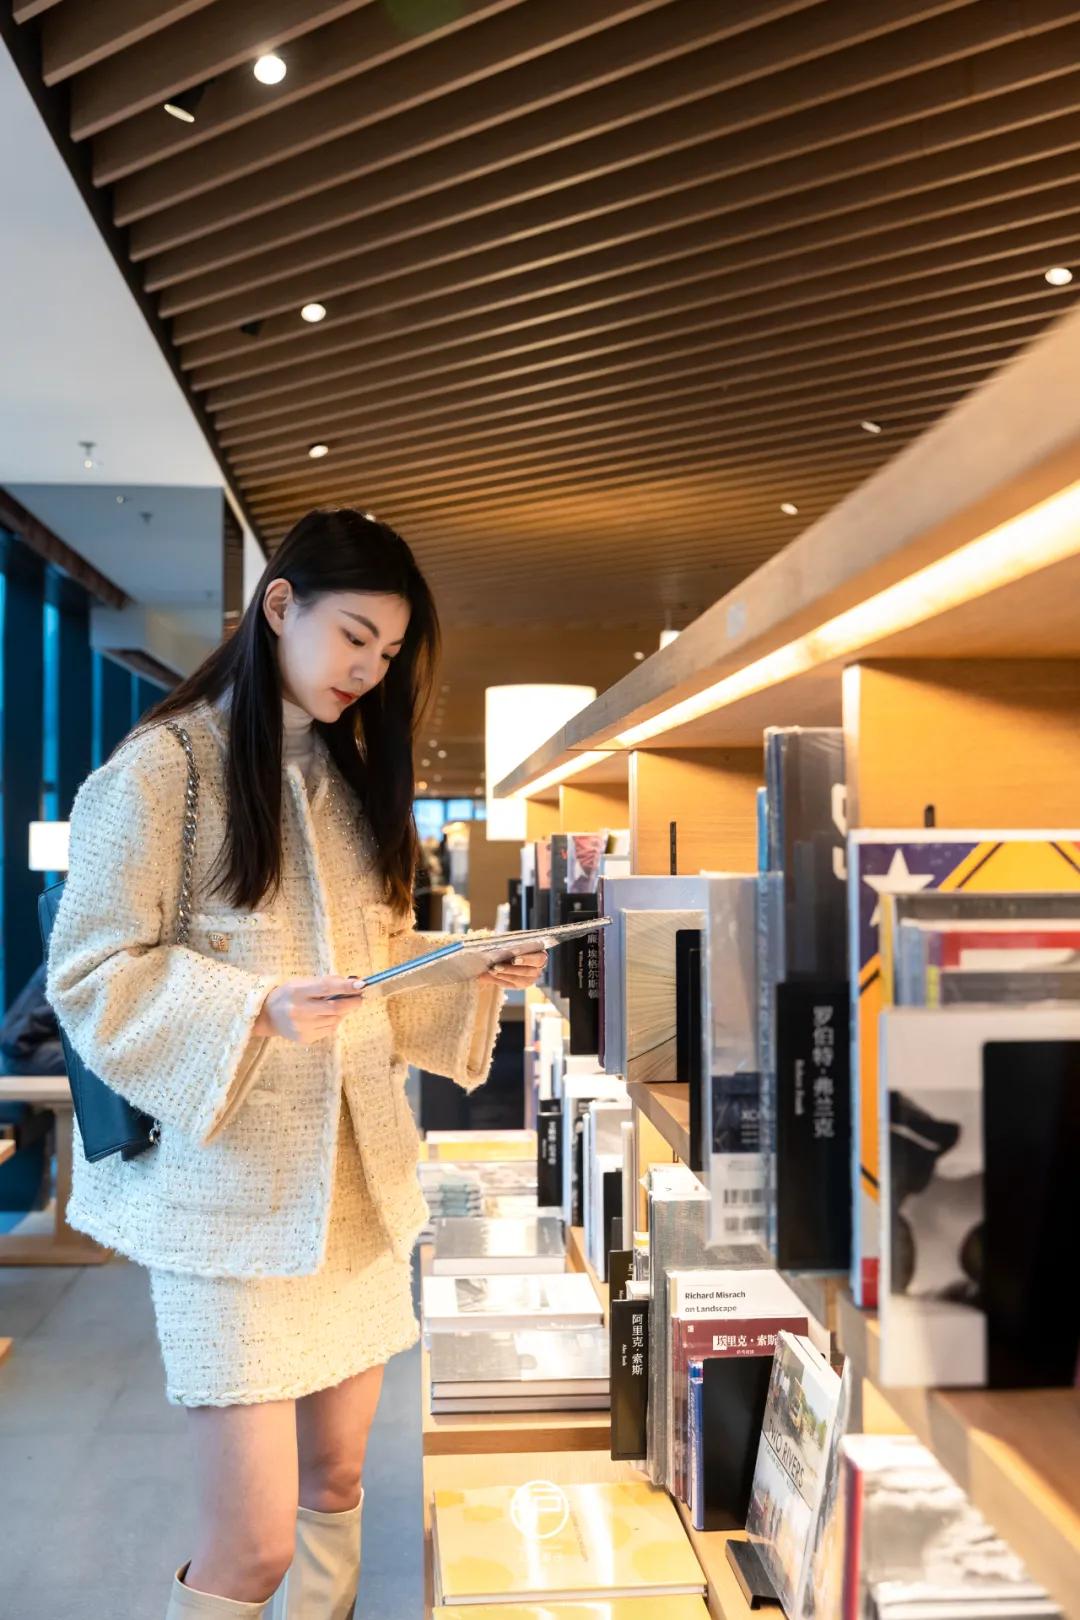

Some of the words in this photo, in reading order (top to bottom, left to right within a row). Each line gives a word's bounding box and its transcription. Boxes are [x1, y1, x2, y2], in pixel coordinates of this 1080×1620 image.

[685, 1291, 714, 1299] Richard
[716, 1290, 746, 1299] Misrach
[697, 1305, 737, 1313] Landscape
[632, 1314, 643, 1376] 阿里克·索斯
[782, 1441, 805, 1489] RIVERS
